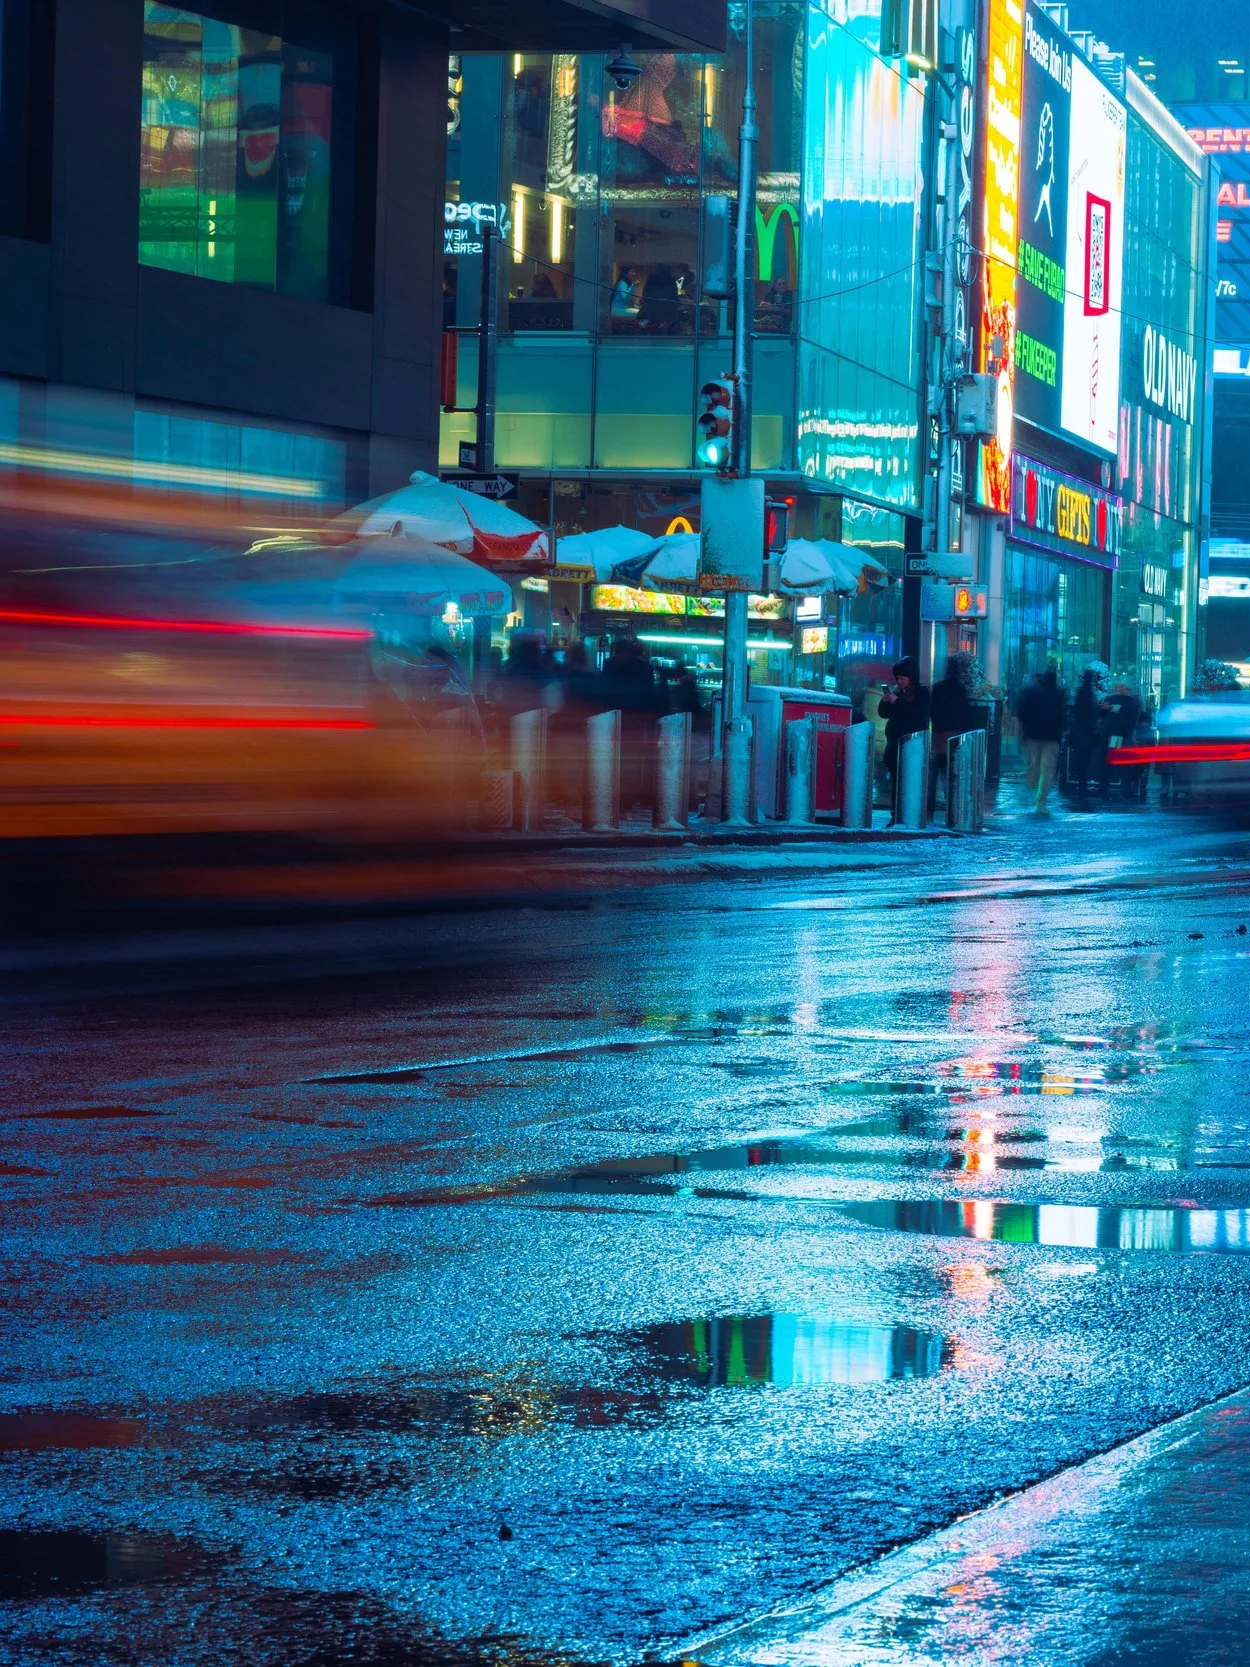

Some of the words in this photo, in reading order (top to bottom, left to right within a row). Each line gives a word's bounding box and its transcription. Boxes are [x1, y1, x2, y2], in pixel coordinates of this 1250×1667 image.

[1025, 11, 1049, 71] Please
[1049, 38, 1061, 84] Join
[1062, 51, 1071, 93] Us
[1215, 280, 1236, 296] /7c
[1143, 324, 1166, 407] OLD
[1168, 341, 1197, 425] NAVY
[485, 482, 507, 492] WAY
[1036, 472, 1055, 534] NY
[1057, 484, 1090, 546] GIFTS
